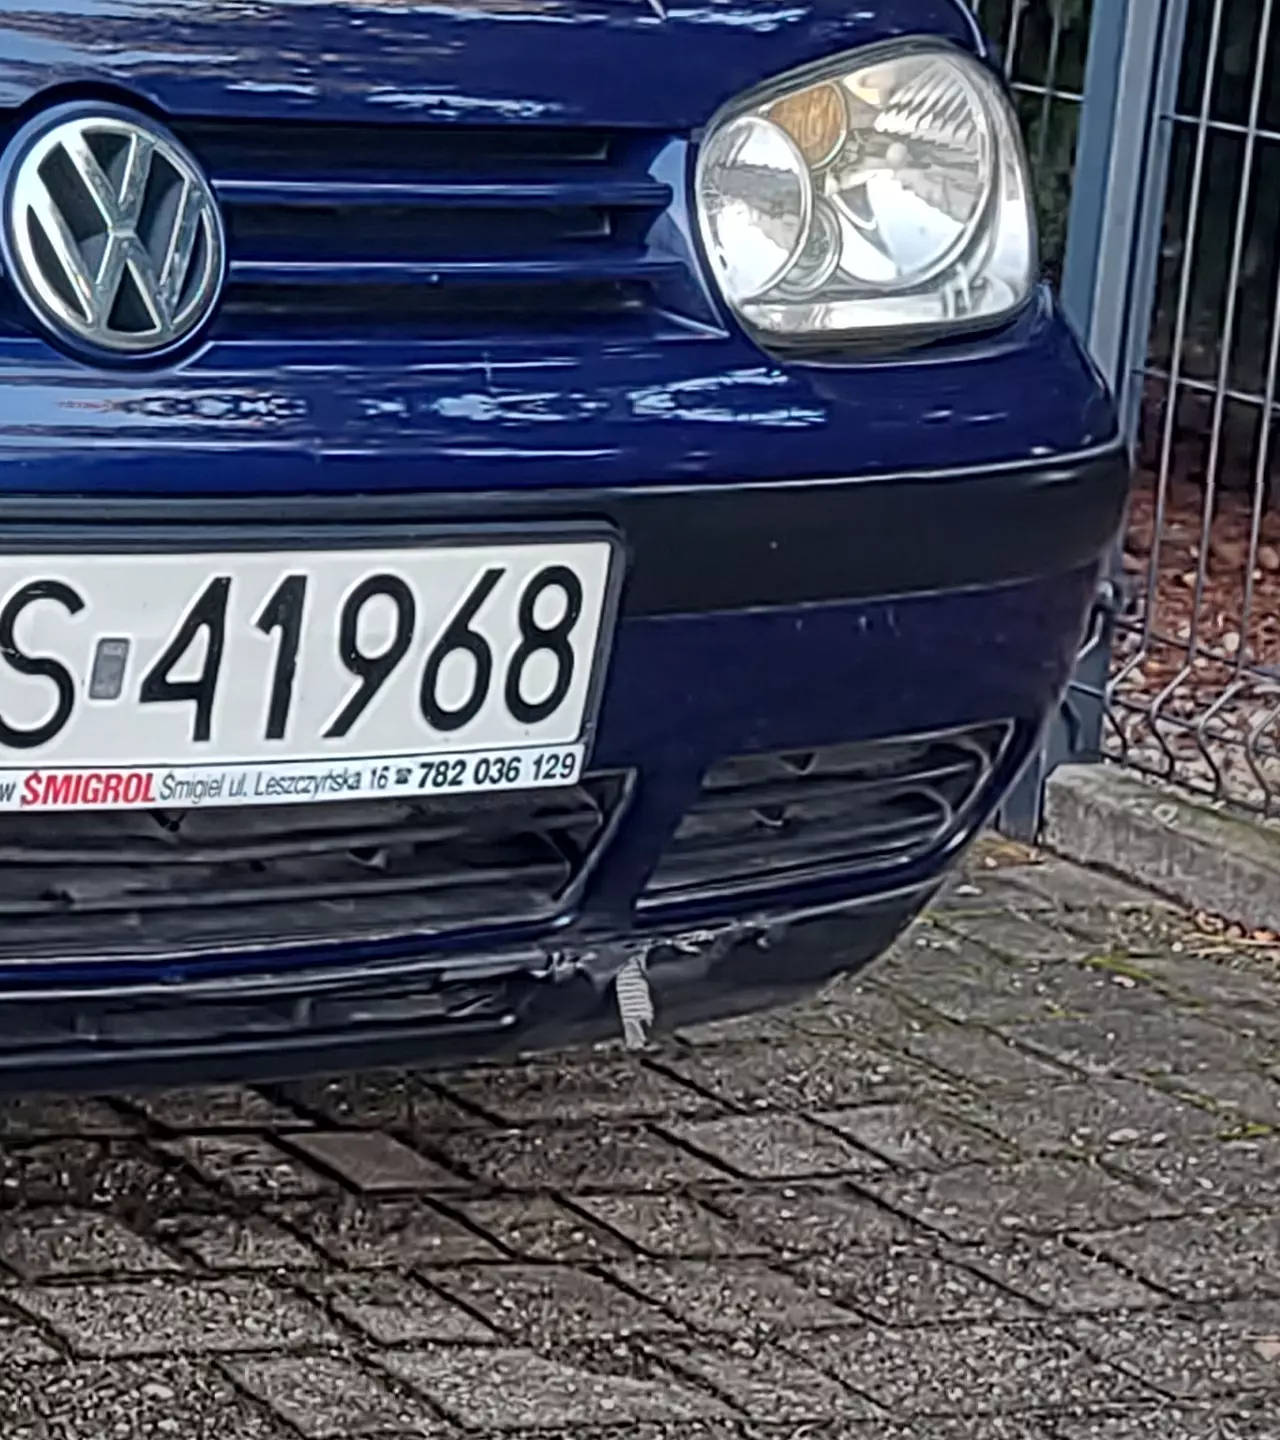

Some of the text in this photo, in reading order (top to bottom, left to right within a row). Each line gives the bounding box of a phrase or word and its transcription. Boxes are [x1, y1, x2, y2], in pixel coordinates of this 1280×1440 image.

[140, 565, 586, 741] 41968
[20, 769, 156, 807] ŚMIGROL
[159, 770, 225, 804] Śmigiel
[228, 776, 247, 797] ul.
[254, 767, 362, 798] Leszczyńska
[369, 766, 388, 790] 16
[417, 759, 467, 789] 782
[473, 756, 522, 784] 036
[532, 752, 577, 781] 129
